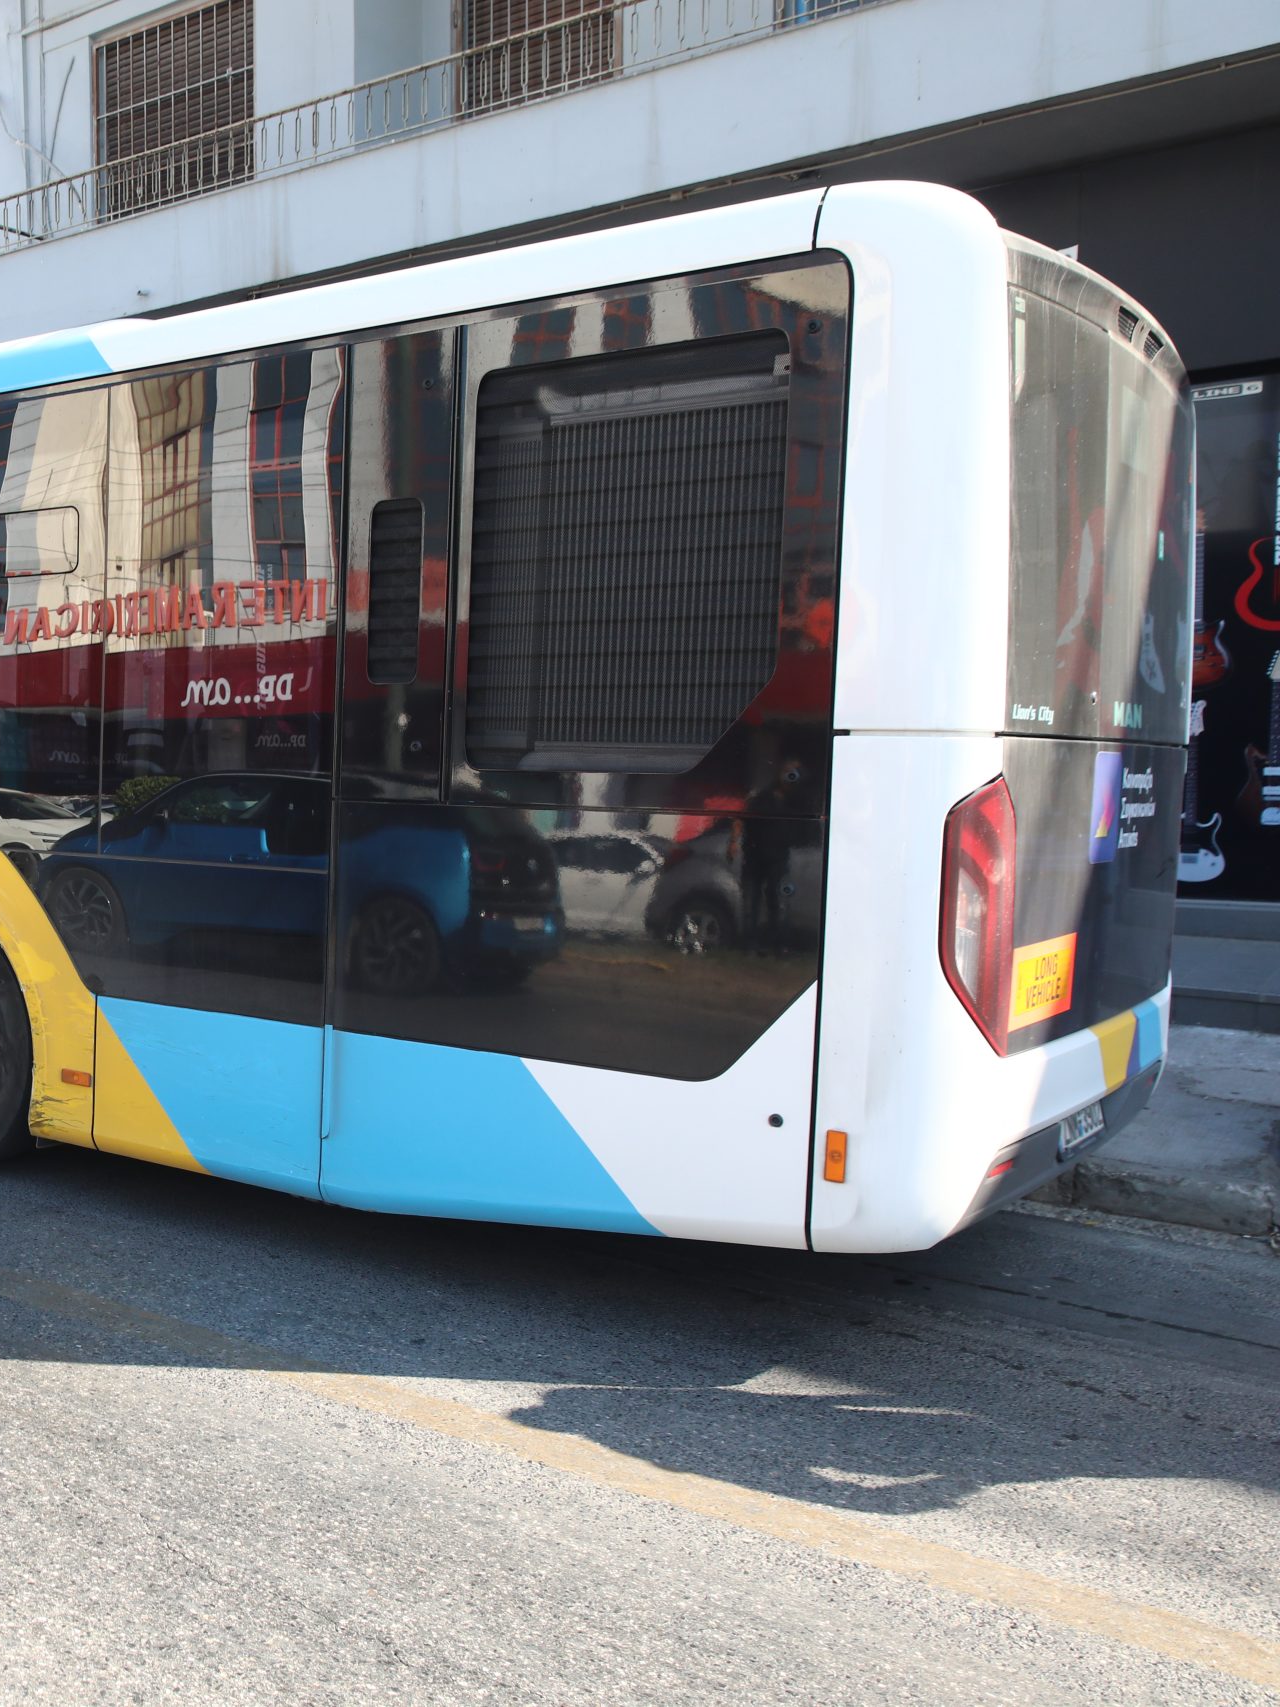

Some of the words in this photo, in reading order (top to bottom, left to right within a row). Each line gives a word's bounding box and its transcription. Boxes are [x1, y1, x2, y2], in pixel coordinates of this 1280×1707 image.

[1012, 703, 1036, 720] Lion's
[1037, 705, 1055, 725] City
[1113, 700, 1143, 729] MAN
[1034, 954, 1058, 981] LONG
[1025, 977, 1061, 1010] VEHICLE
